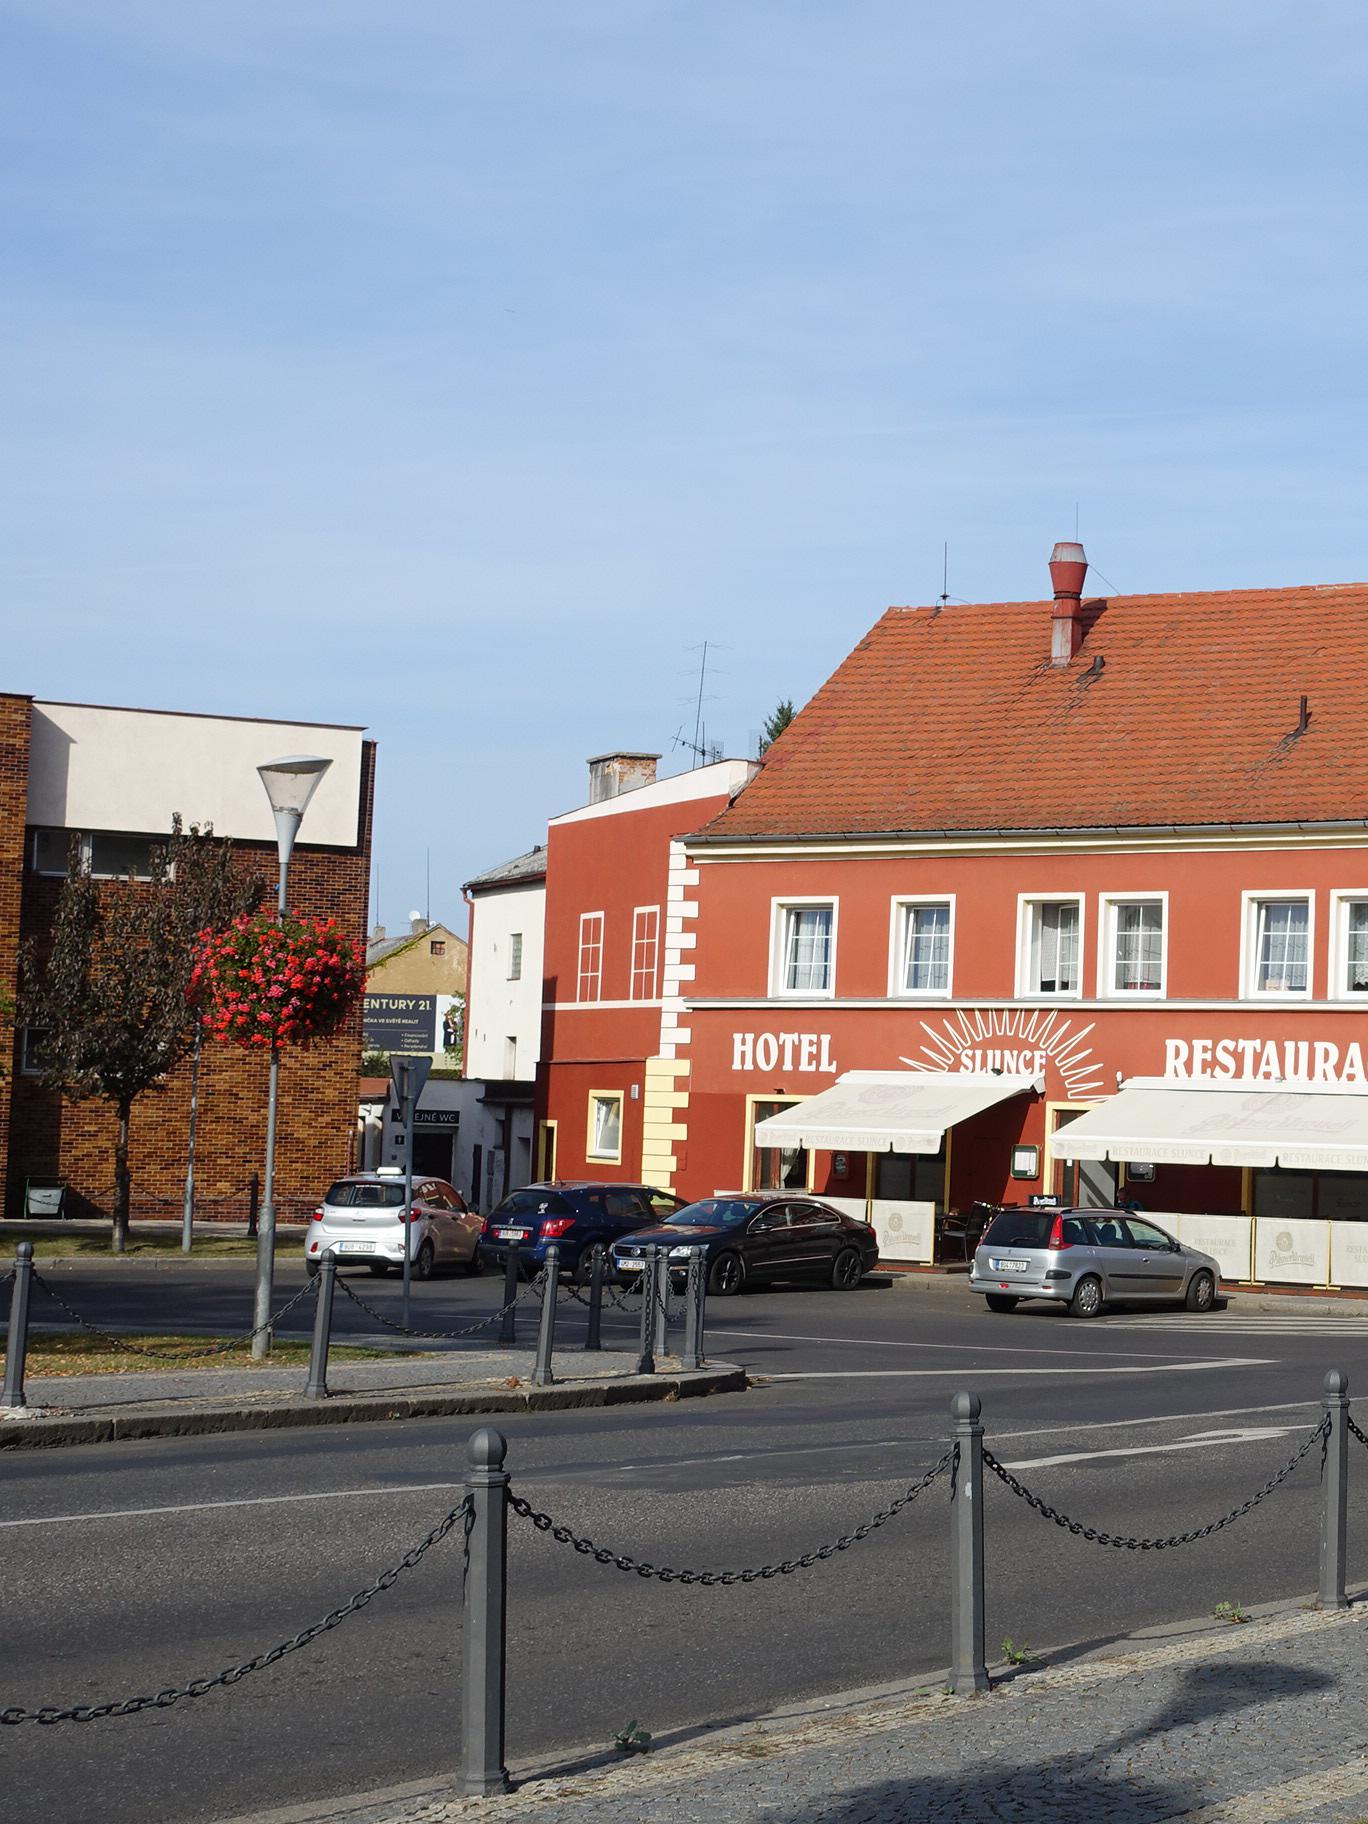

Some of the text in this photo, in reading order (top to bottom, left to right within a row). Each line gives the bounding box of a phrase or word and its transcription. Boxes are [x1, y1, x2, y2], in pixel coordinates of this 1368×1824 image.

[363, 998, 416, 1010] ENTURY
[731, 1032, 837, 1073] HOTEL
[959, 1049, 1047, 1075] SLUNCE
[396, 1111, 456, 1122] VEJNÉ WC
